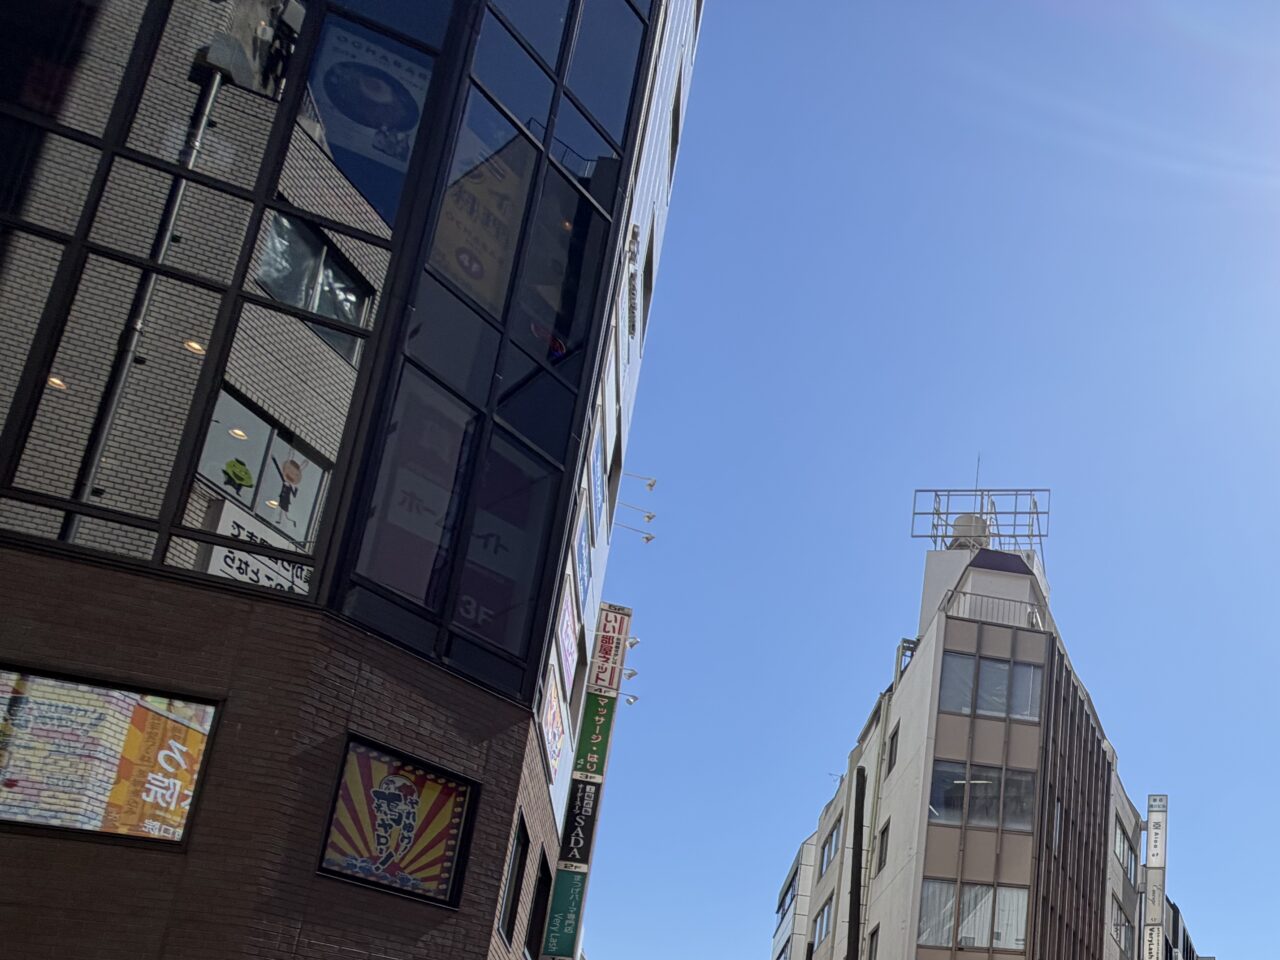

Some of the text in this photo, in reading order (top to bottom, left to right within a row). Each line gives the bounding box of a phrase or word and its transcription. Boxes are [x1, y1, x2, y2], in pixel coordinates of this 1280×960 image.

[595, 612, 618, 685] いい部屋ネット
[568, 815, 585, 859] SADA
